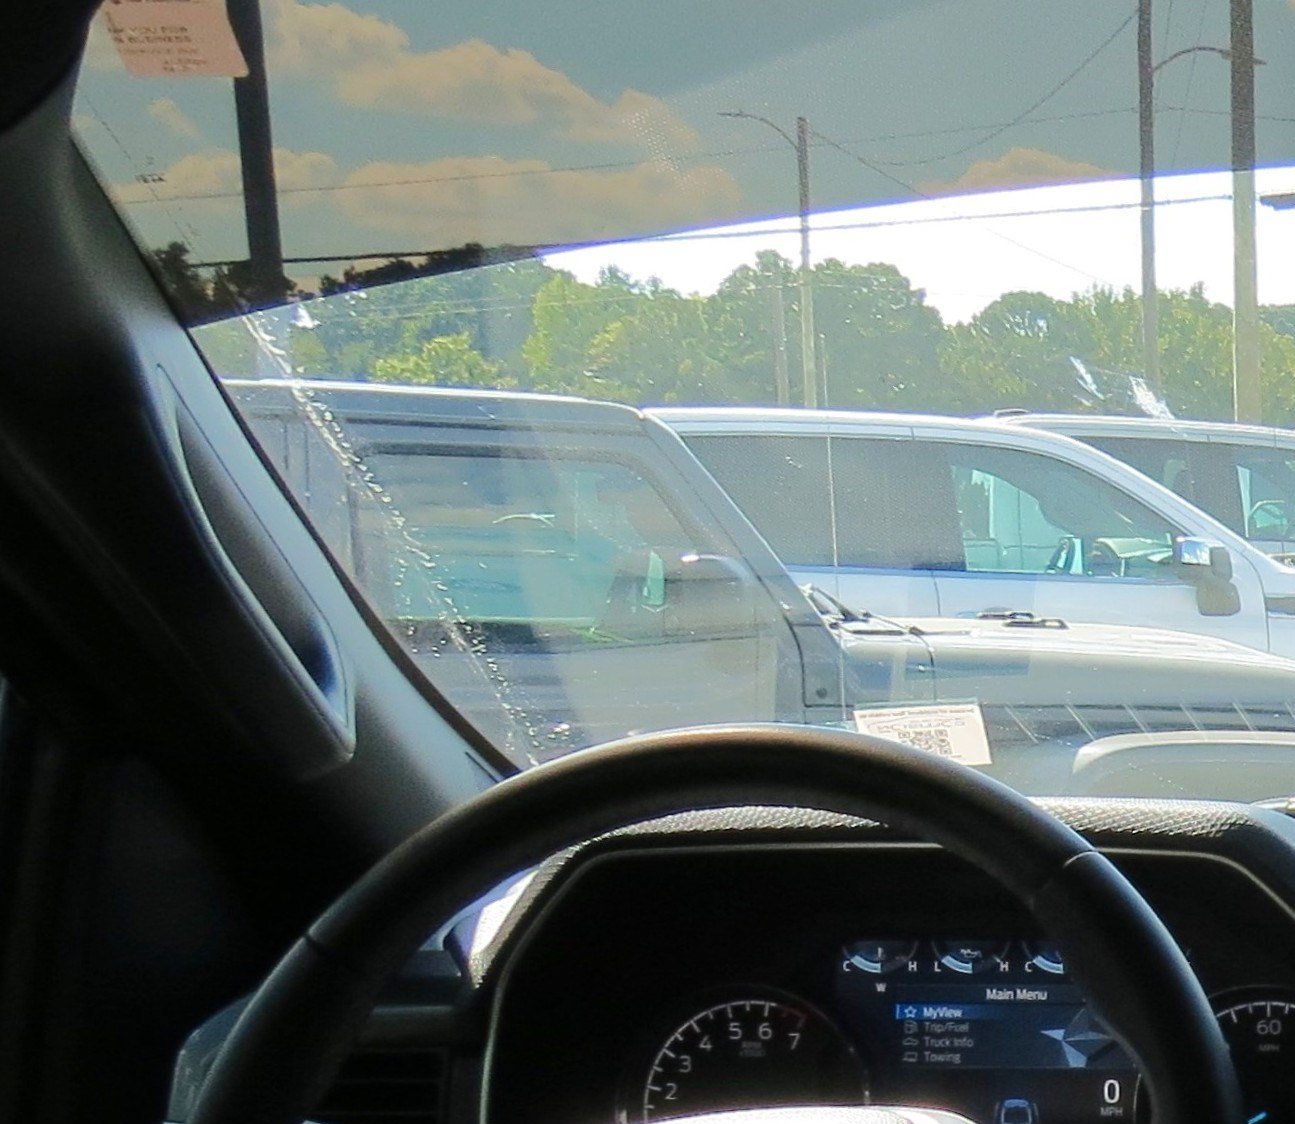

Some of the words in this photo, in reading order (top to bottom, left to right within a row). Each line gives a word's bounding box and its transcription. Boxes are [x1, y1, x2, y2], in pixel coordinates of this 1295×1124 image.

[908, 961, 918, 972] H
[933, 961, 942, 972] L
[1000, 961, 1009, 972] H
[986, 988, 1014, 1001] Main
[1016, 988, 1048, 1001] Menu
[923, 1007, 963, 1020] MyView
[728, 1023, 743, 1039] 5
[758, 1023, 773, 1039] 6
[923, 1021, 970, 1034] Trip/Fuel
[1257, 1020, 1281, 1035] 60
[699, 1036, 713, 1052] 4
[788, 1033, 801, 1050] 7
[923, 1036, 954, 1047] Truck
[956, 1036, 974, 1047] Info
[923, 1051, 962, 1064] Towing
[679, 1056, 692, 1073] 3
[665, 1084, 678, 1100] 2
[1102, 1079, 1121, 1105] 0
[1100, 1107, 1124, 1117] MPH
